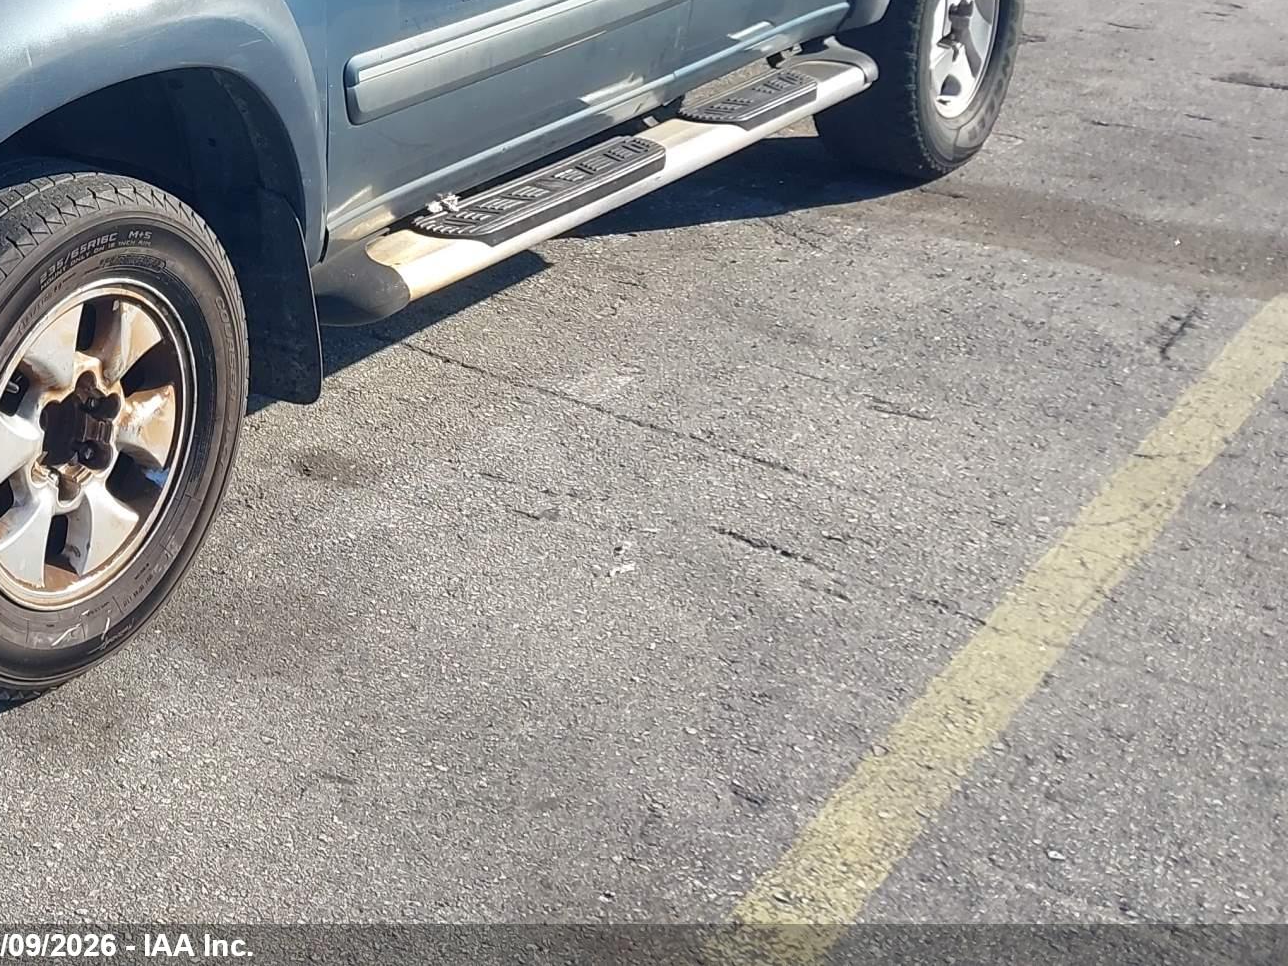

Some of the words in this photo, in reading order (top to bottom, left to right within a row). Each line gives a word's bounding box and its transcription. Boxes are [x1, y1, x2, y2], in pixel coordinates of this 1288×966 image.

[128, 230, 153, 240] M+S
[41, 267, 66, 290] MOUNT
[70, 253, 90, 267] ONLY
